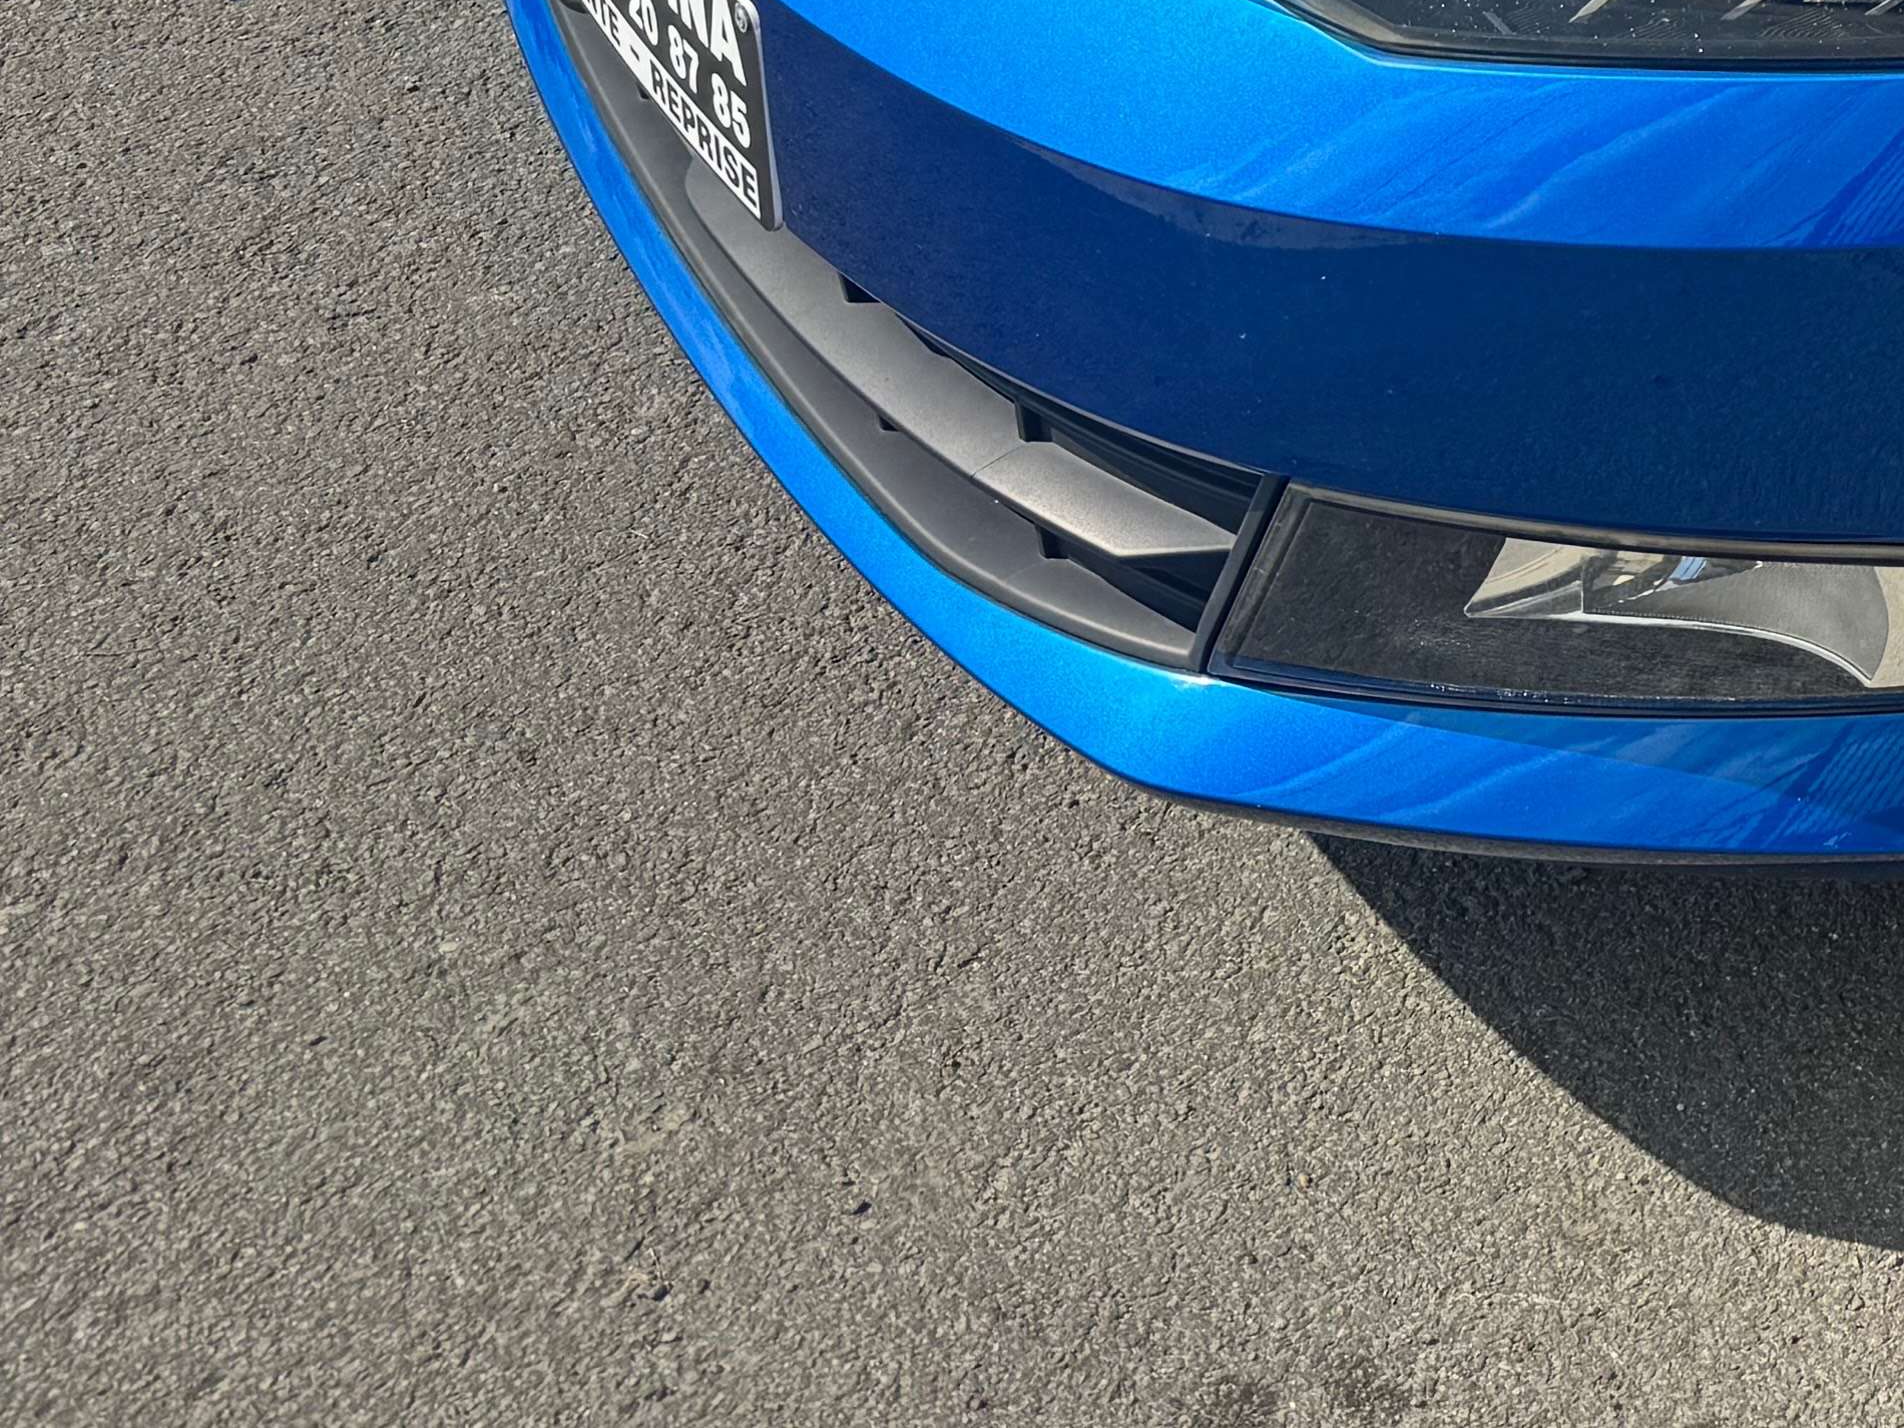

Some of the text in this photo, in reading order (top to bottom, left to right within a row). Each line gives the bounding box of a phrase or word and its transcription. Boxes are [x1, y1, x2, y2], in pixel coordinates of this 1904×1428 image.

[650, 58, 758, 210] REPRISE
[667, 25, 699, 93] 87
[711, 72, 751, 148] 85
